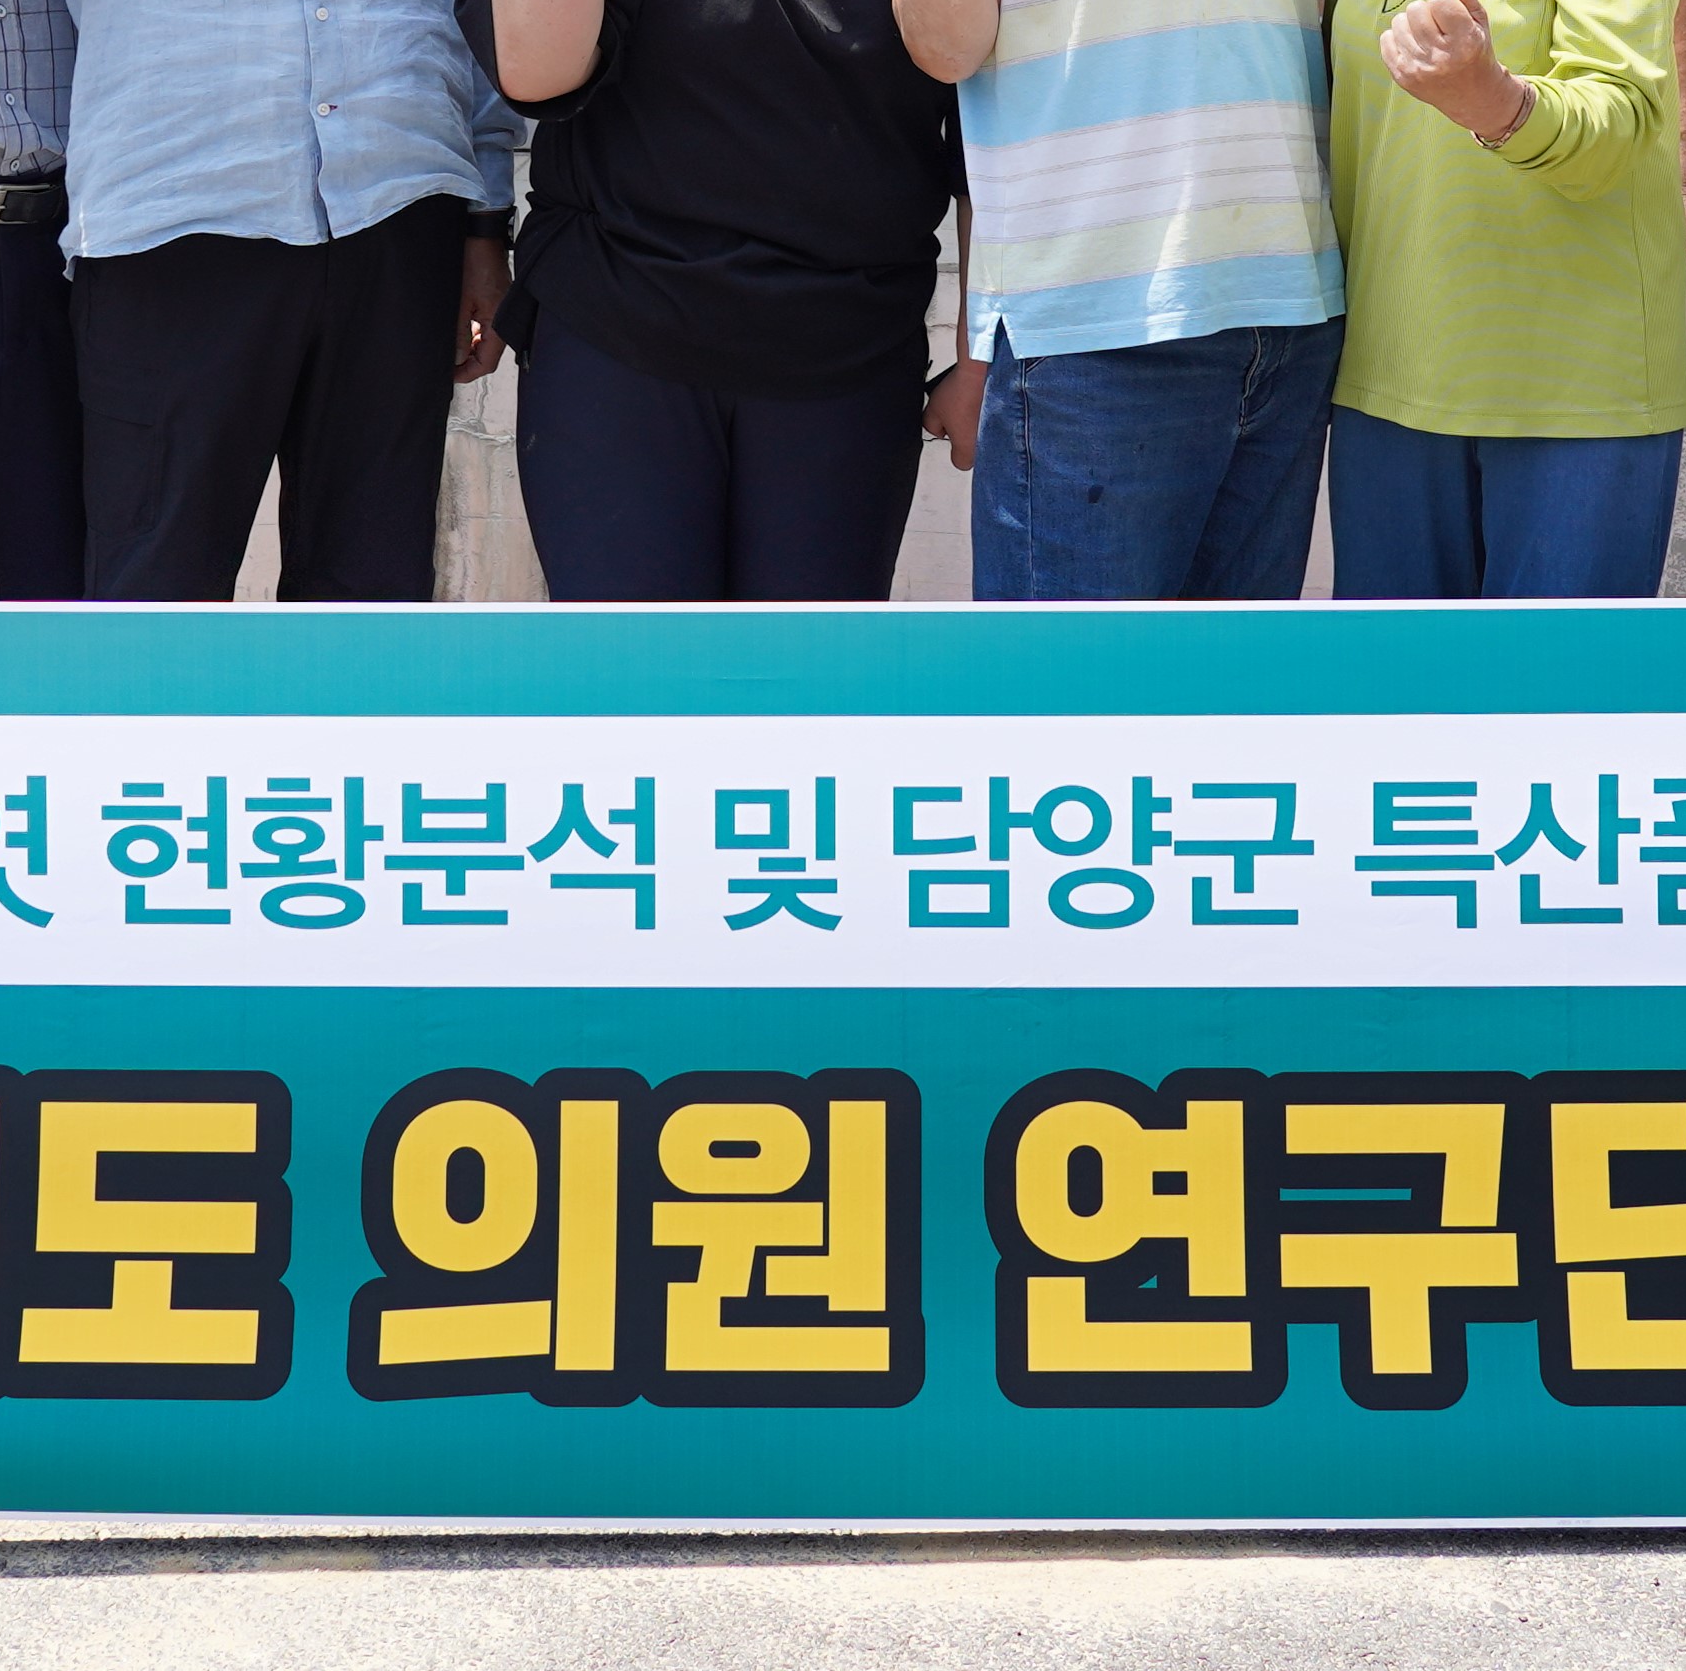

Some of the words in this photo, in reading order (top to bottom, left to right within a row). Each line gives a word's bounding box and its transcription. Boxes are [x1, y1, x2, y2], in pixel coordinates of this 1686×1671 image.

[101, 776, 658, 932] 현황분석
[714, 776, 844, 933] 및
[893, 775, 1316, 934] 담양군
[378, 1098, 893, 1374] 의원
